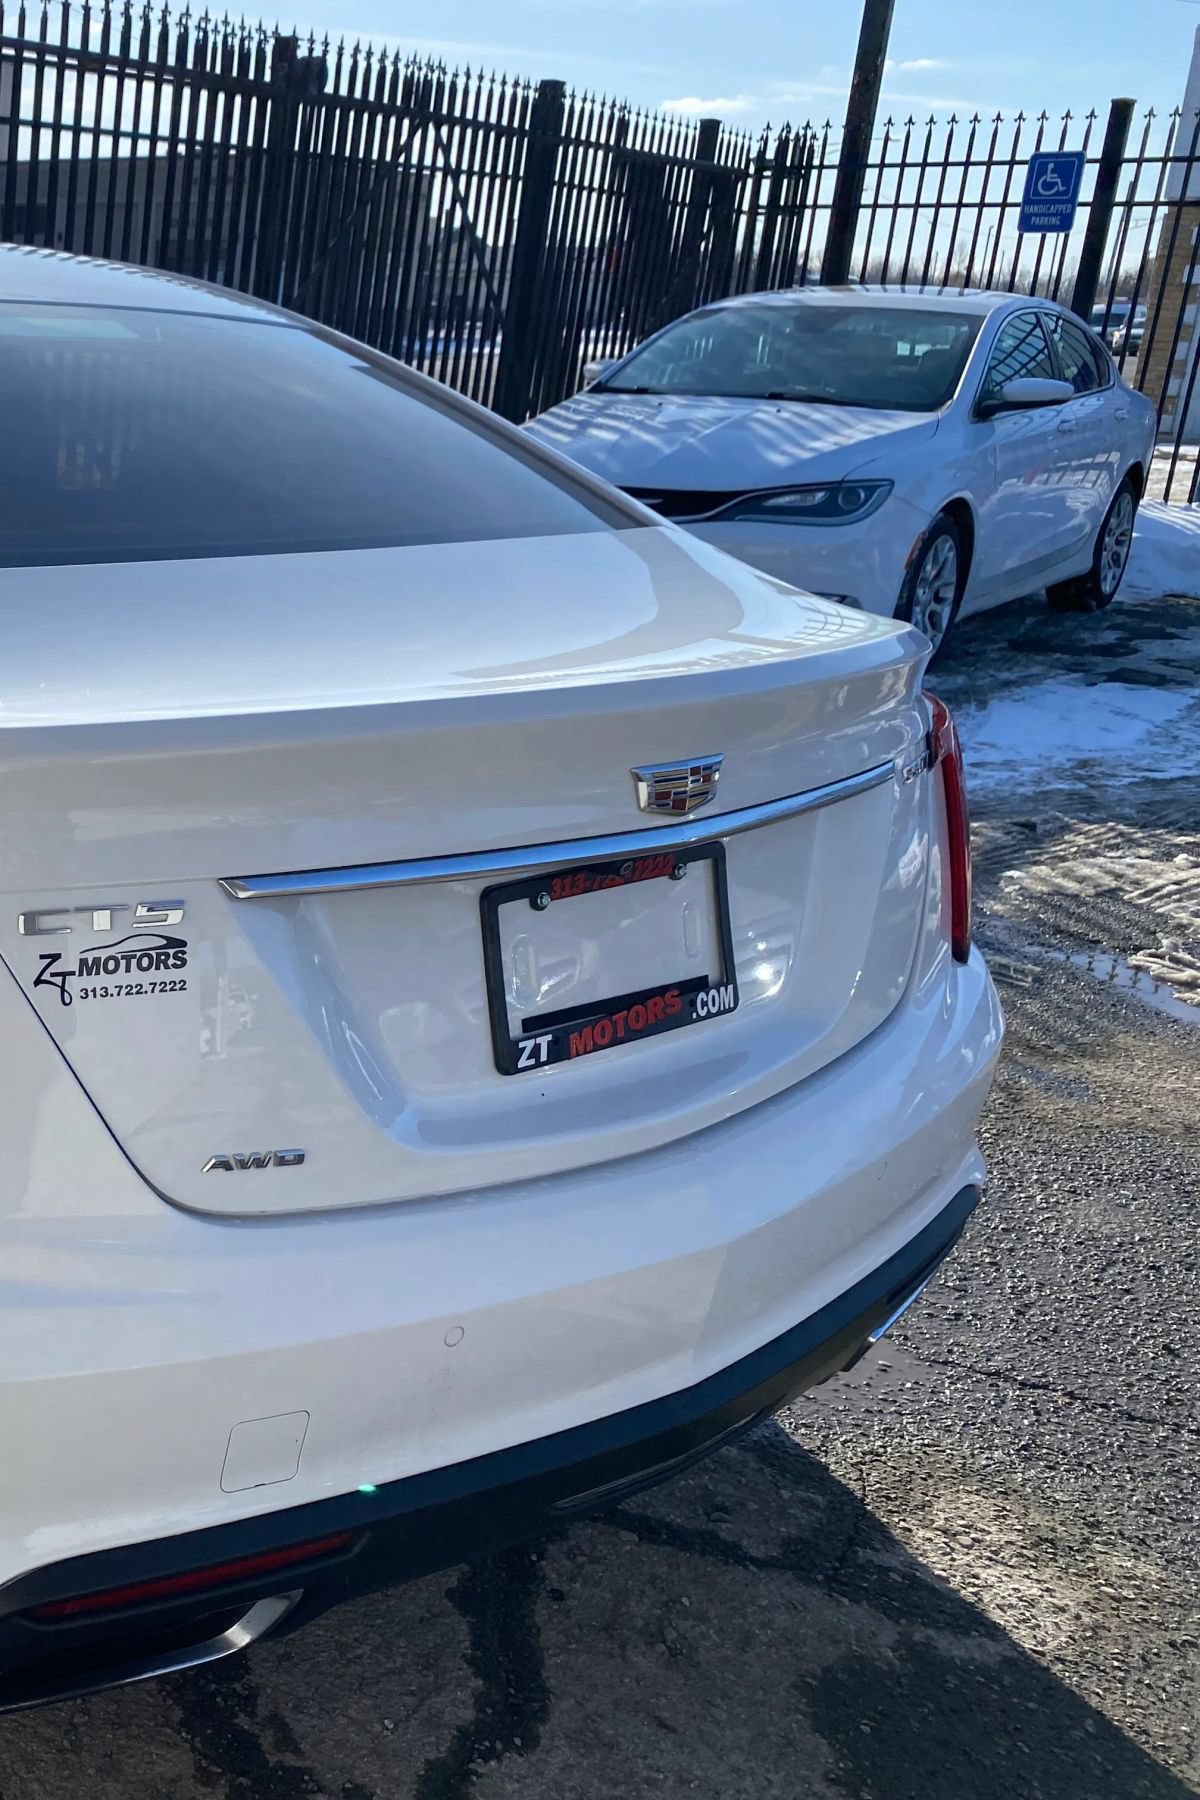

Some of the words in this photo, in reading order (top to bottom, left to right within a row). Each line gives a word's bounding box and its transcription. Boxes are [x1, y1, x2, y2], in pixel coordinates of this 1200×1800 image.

[1023, 204, 1073, 214] HANDICAPPED
[1030, 215, 1061, 226] PARKING
[76, 949, 188, 977] MOTORS
[79, 978, 188, 1000] 313.722.7222
[516, 1033, 553, 1069] ZT
[568, 988, 684, 1059] MOTORS
[692, 984, 735, 1020] .COM
[199, 1147, 306, 1173] AWD
